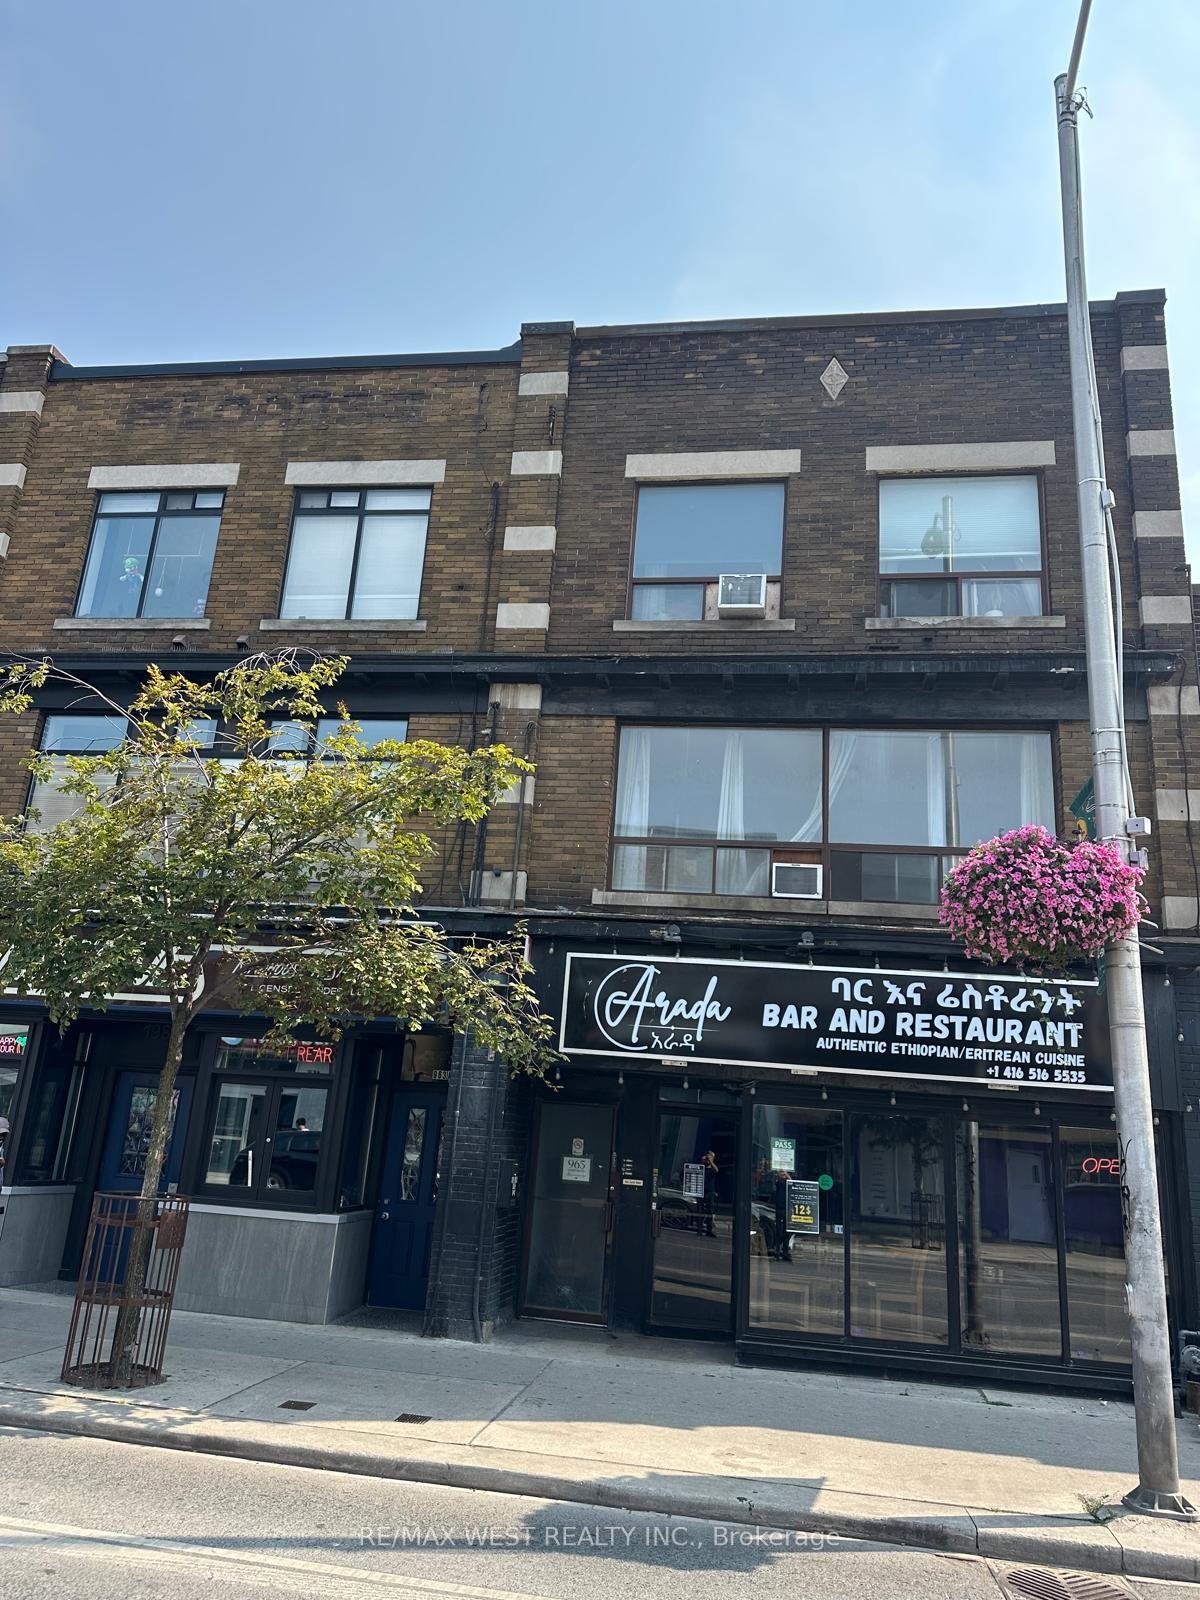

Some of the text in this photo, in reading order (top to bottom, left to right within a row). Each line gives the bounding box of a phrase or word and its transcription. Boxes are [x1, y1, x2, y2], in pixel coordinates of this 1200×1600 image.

[831, 977, 874, 1005] ባር
[604, 964, 732, 1043] Arada
[762, 1003, 1084, 1048] BAR AND RESTAURANT
[0, 1036, 17, 1045] APPY
[0, 1045, 14, 1054] OUR
[296, 1046, 332, 1064] REAR
[816, 1037, 1086, 1067] AUTHENTIC ETHIOPIAN/ERITREAN CUISINE
[986, 1065, 1086, 1083] +1 416 516 5535
[775, 1140, 792, 1149] PASS
[567, 1159, 586, 1170] 965
[1082, 1157, 1120, 1174] OPE
[794, 1204, 812, 1215] 12$
